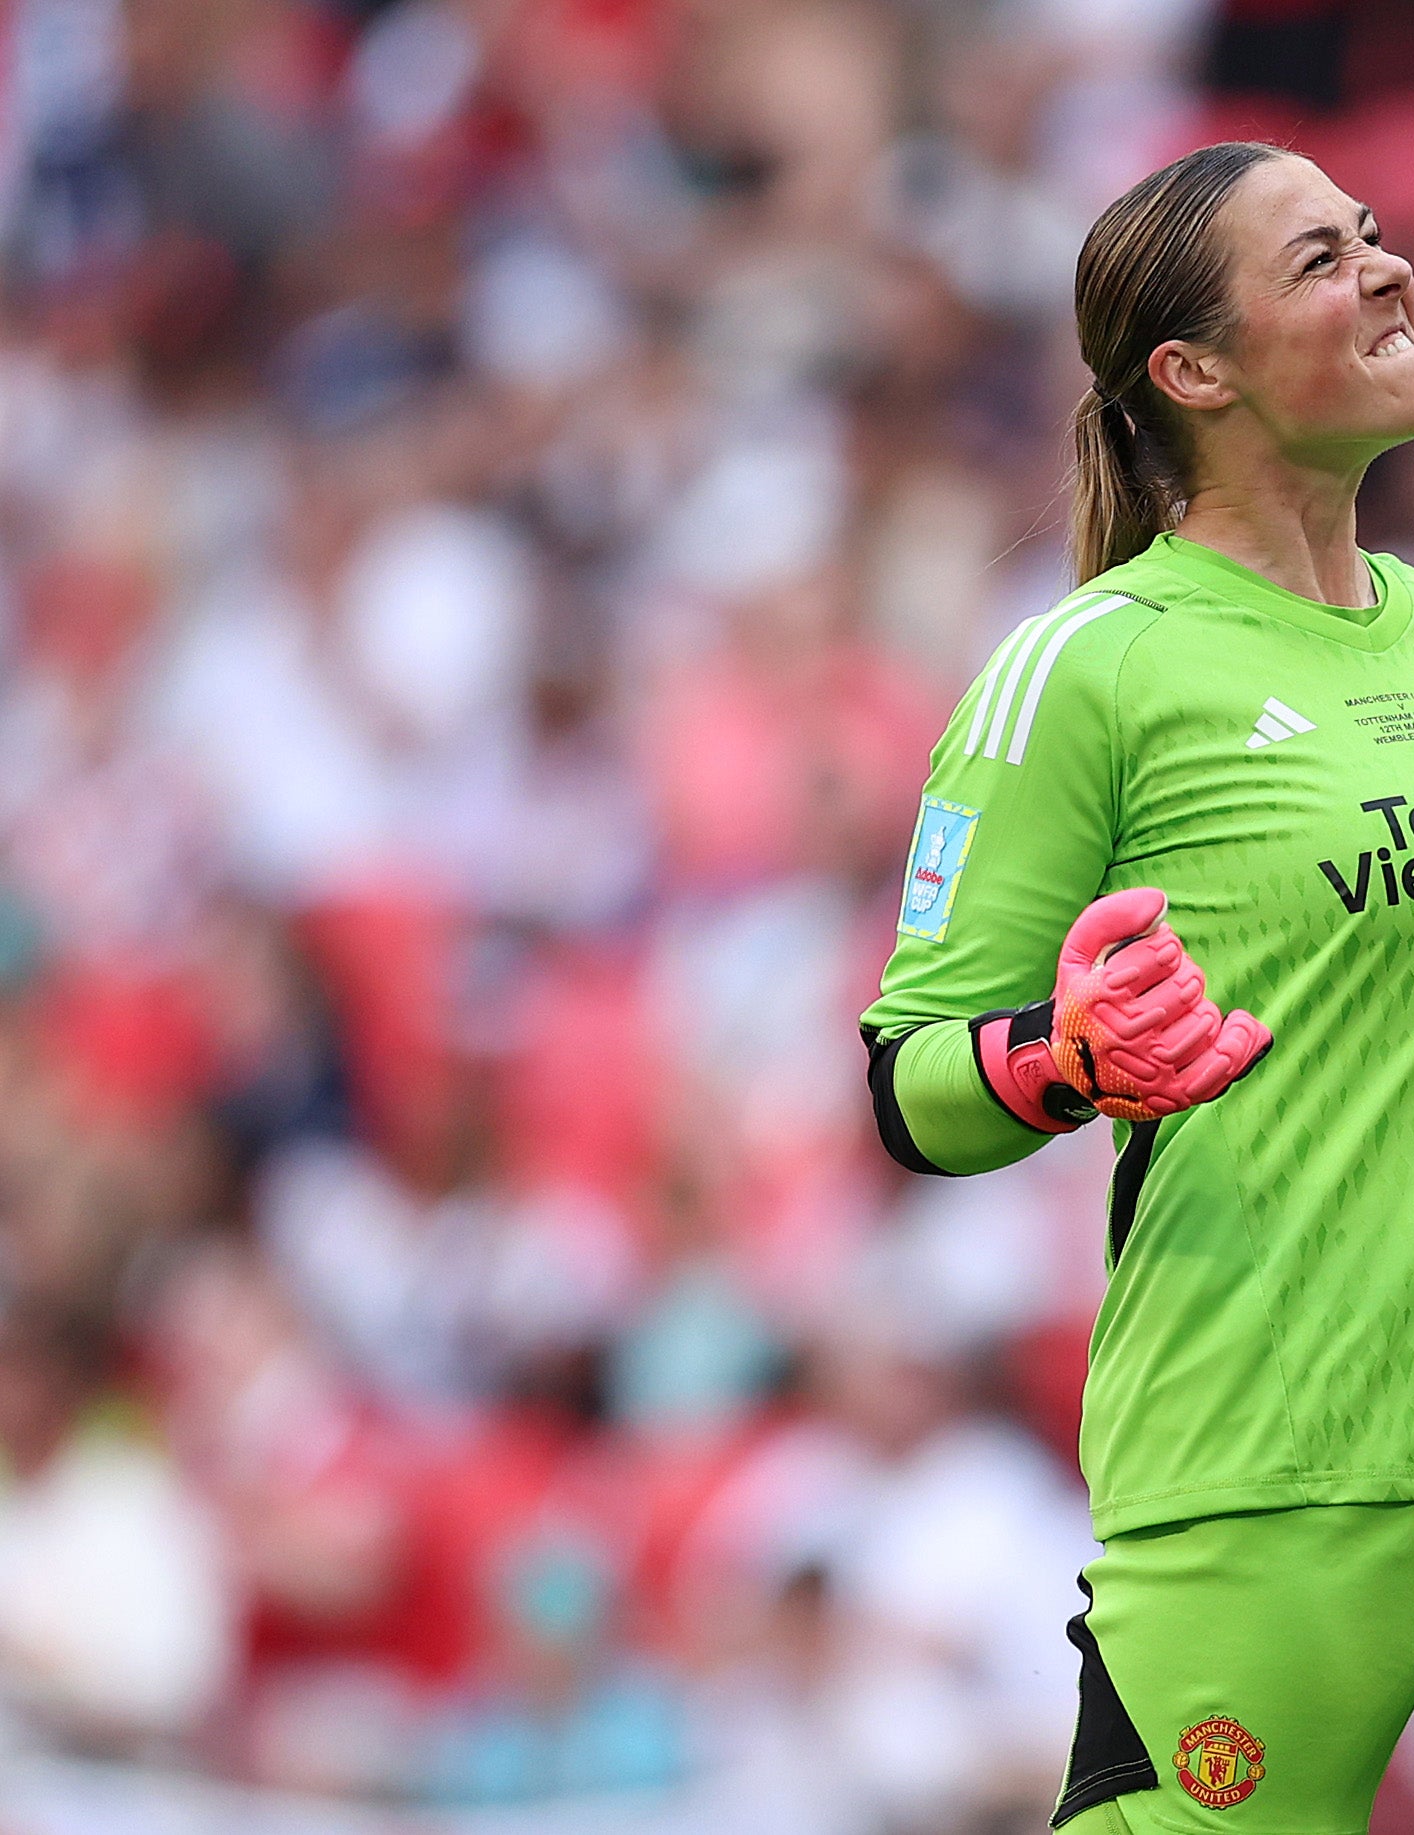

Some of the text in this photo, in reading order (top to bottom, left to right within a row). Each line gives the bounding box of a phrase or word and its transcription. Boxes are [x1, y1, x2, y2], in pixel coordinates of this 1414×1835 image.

[1345, 693, 1410, 707] MANCHESTER
[1354, 713, 1413, 727] TOTTENHAM
[1380, 724, 1402, 733] 12TH
[911, 896, 932, 912] CUP
[1185, 1722, 1257, 1758] MANCHESTER
[1190, 1783, 1241, 1802] UNITED
